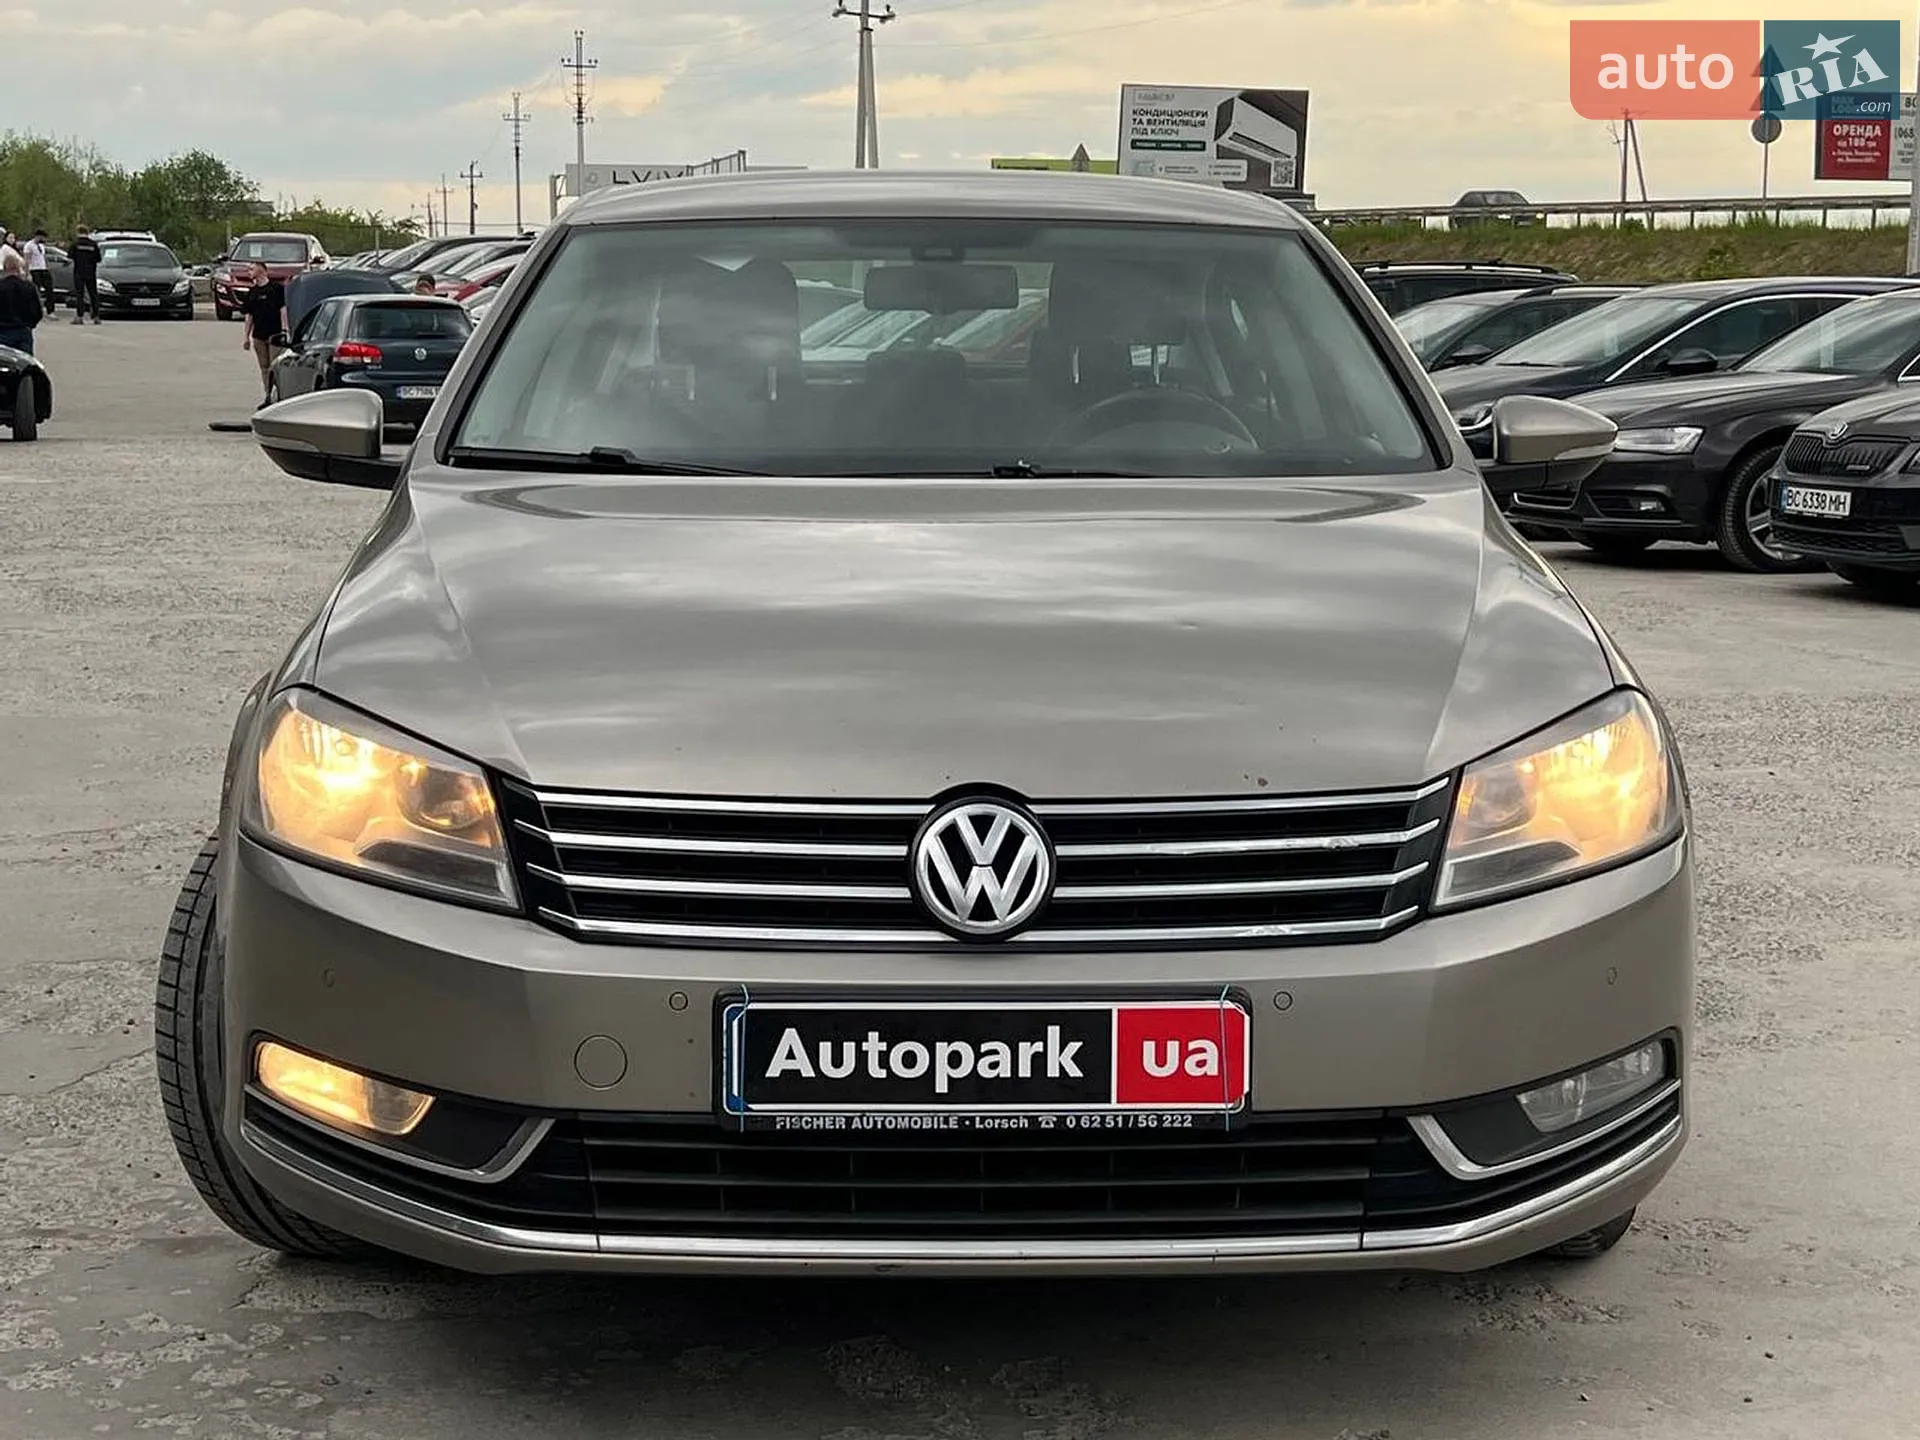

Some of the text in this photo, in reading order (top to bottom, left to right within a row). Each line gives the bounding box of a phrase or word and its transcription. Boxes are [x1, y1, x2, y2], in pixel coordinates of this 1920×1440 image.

[1132, 108, 1209, 118] КОНДИЦІОНЕРИ
[1132, 118, 1206, 128] ТА ВЕНТИЛЯЦІЯ
[1131, 127, 1179, 136] ПІД КЛЮЧ
[1833, 124, 1881, 137] ОРЕНДА
[1787, 489, 1847, 512] BC 6338 MH
[765, 1025, 1219, 1093] Autopark ua
[776, 1116, 846, 1130] FISCHER
[851, 1115, 958, 1129] AUTOMOBILE
[975, 1115, 1028, 1129] Lorsch
